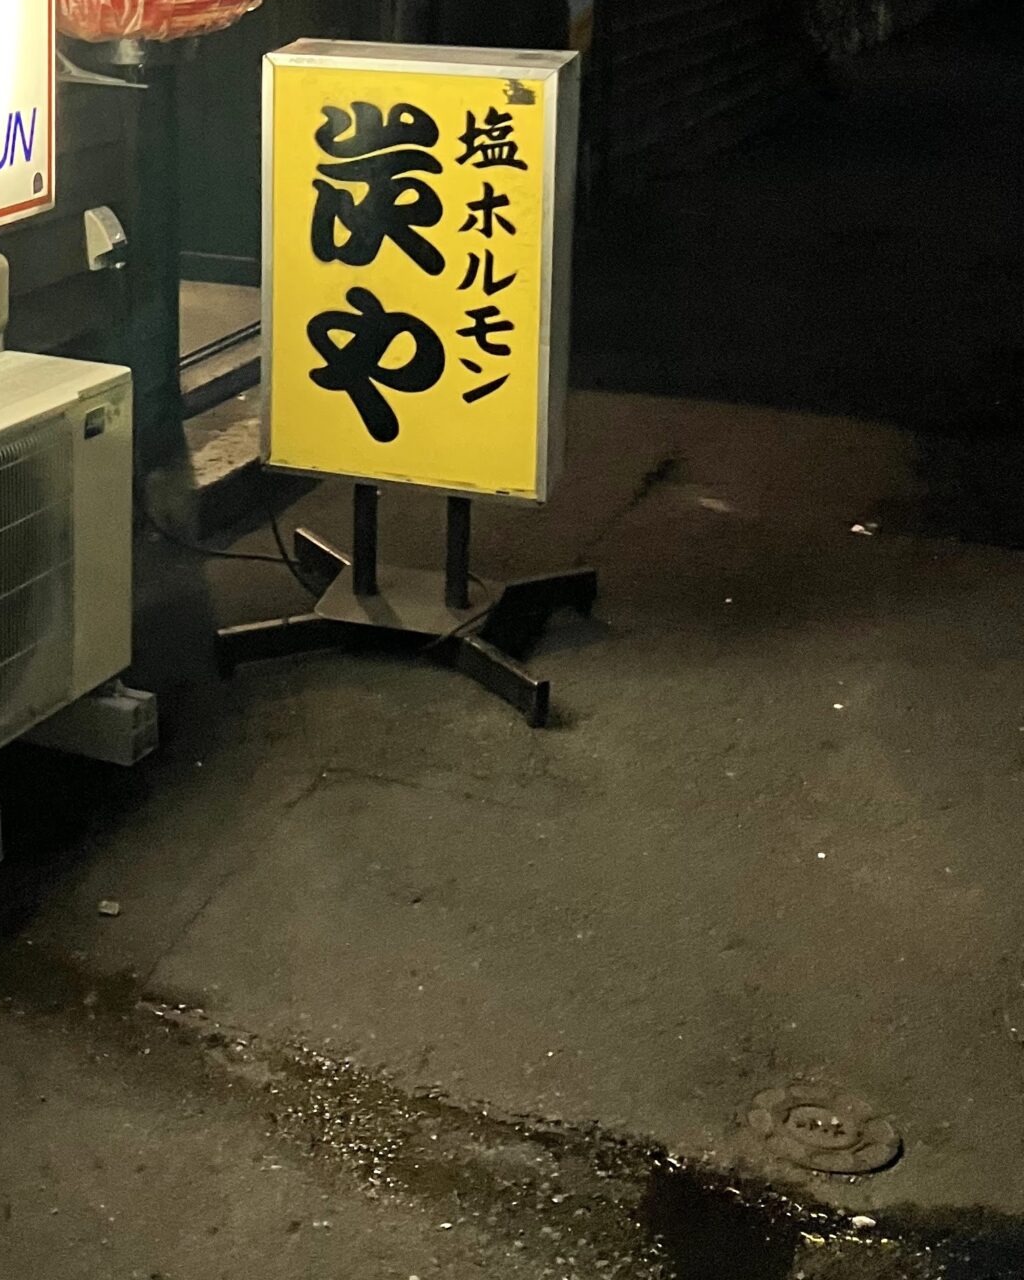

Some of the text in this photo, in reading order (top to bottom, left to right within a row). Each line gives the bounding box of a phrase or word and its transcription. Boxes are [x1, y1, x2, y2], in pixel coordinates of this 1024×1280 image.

[307, 101, 529, 443] 炭や 塩ホルモン
